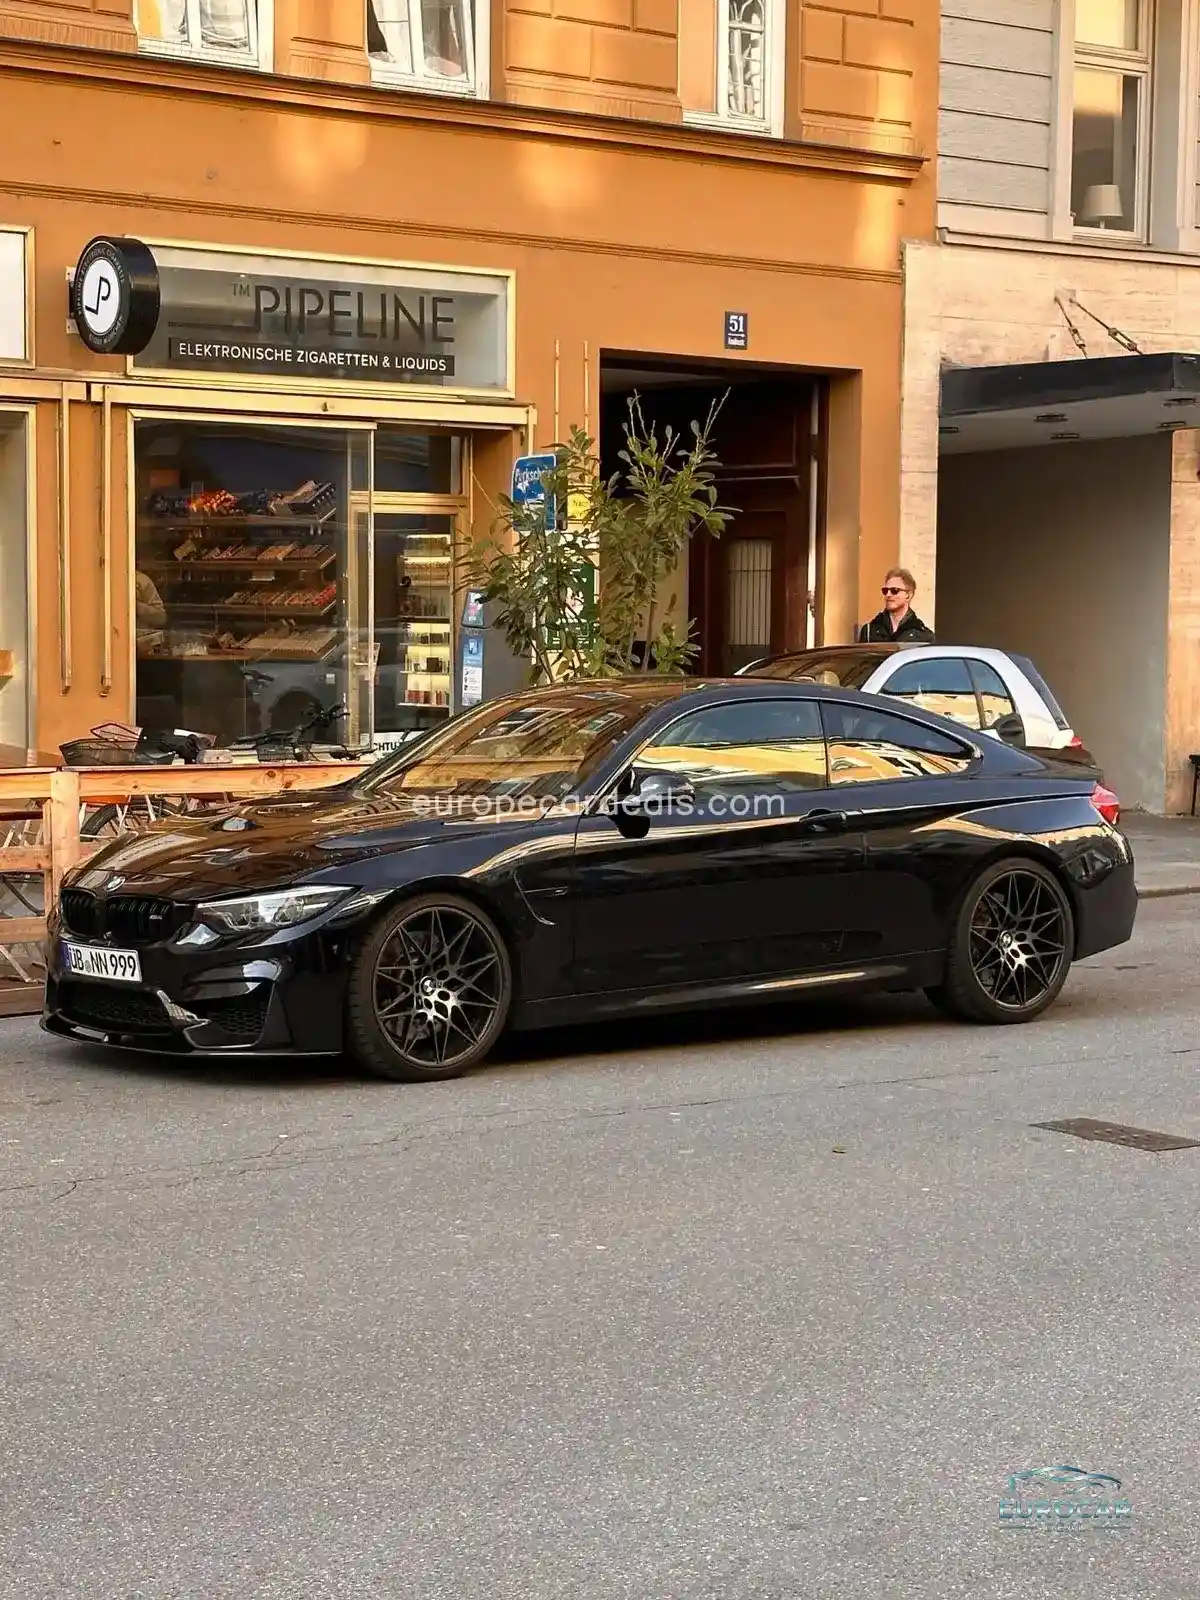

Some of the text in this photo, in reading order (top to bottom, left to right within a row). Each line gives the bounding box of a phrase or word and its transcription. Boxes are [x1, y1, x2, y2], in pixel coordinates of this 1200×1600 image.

[233, 283, 455, 344] TM PIPELINE
[729, 315, 744, 332] 51
[179, 342, 447, 371] ELEKTRONISCHE ZIGARETTEN & LIQUIDS
[110, 954, 136, 977] 999
